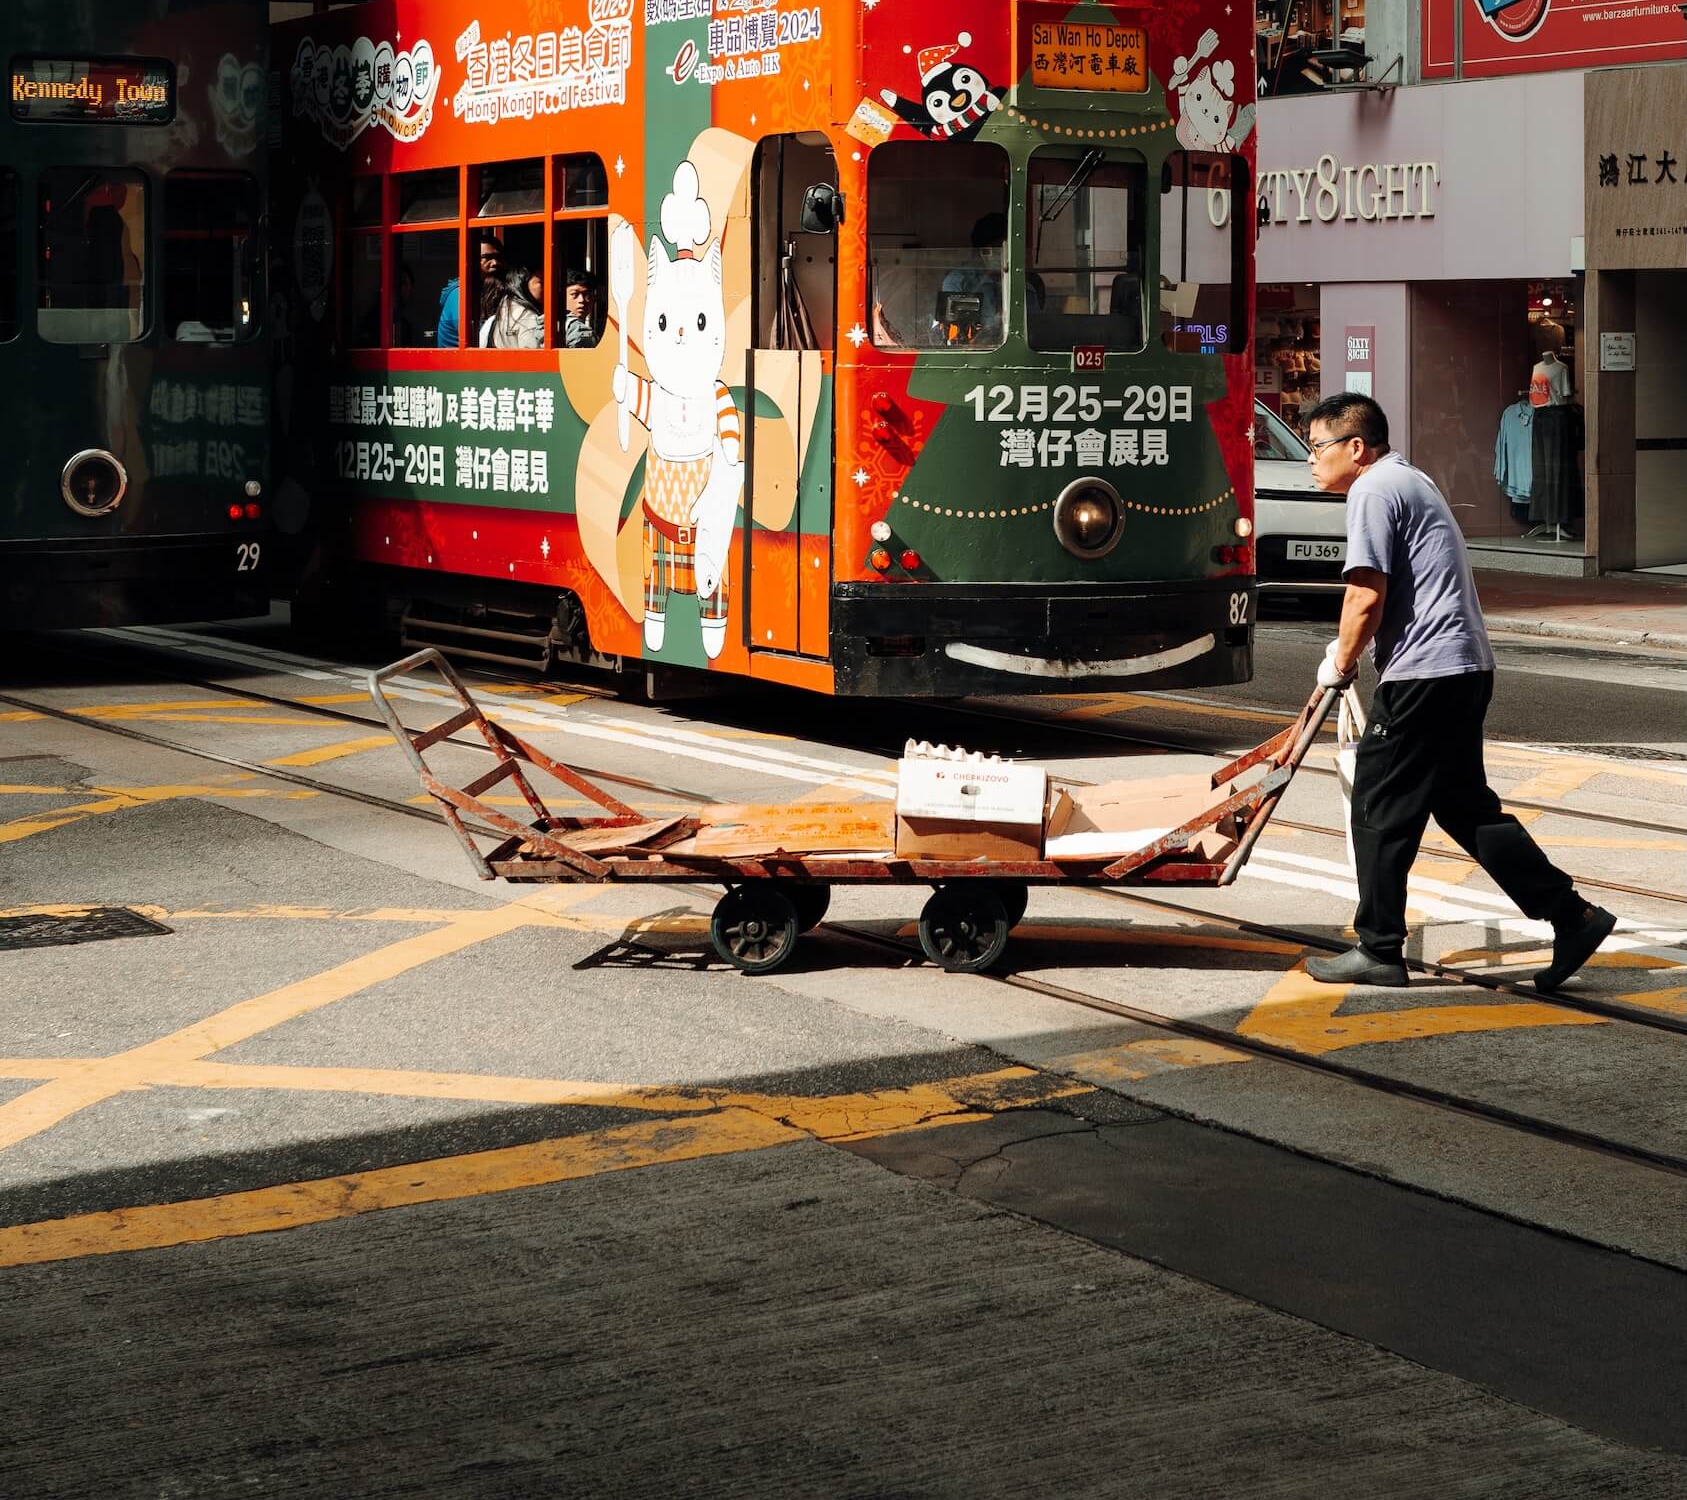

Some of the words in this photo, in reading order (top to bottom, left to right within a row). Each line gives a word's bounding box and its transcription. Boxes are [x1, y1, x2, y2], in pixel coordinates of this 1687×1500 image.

[709, 13, 777, 54] 車品博覽
[780, 9, 820, 41] 2024
[1033, 24, 1052, 45] Sai
[1056, 25, 1081, 47] Wan
[1085, 27, 1102, 48] Ho
[1106, 27, 1140, 51] Depot
[762, 55, 780, 73] HK
[1034, 52, 1141, 77] 西灣河電車廠
[12, 75, 102, 108] Kennedy
[115, 78, 167, 104] Town
[466, 97, 498, 120] Hong
[501, 93, 533, 115] Kong
[1347, 336, 1370, 349] 6IXTY
[1076, 351, 1102, 367] 025
[964, 385, 1193, 423] 12月25-29日
[999, 429, 1169, 468] 灣仔會展見
[336, 442, 445, 487] 12月25-29日
[455, 445, 549, 494] 灣仔會展見
[236, 542, 261, 572] 29
[1295, 544, 1312, 557] FU
[1315, 545, 1340, 558] 369
[1229, 593, 1249, 625] 82
[953, 772, 1009, 784] CHERKIZOVO
